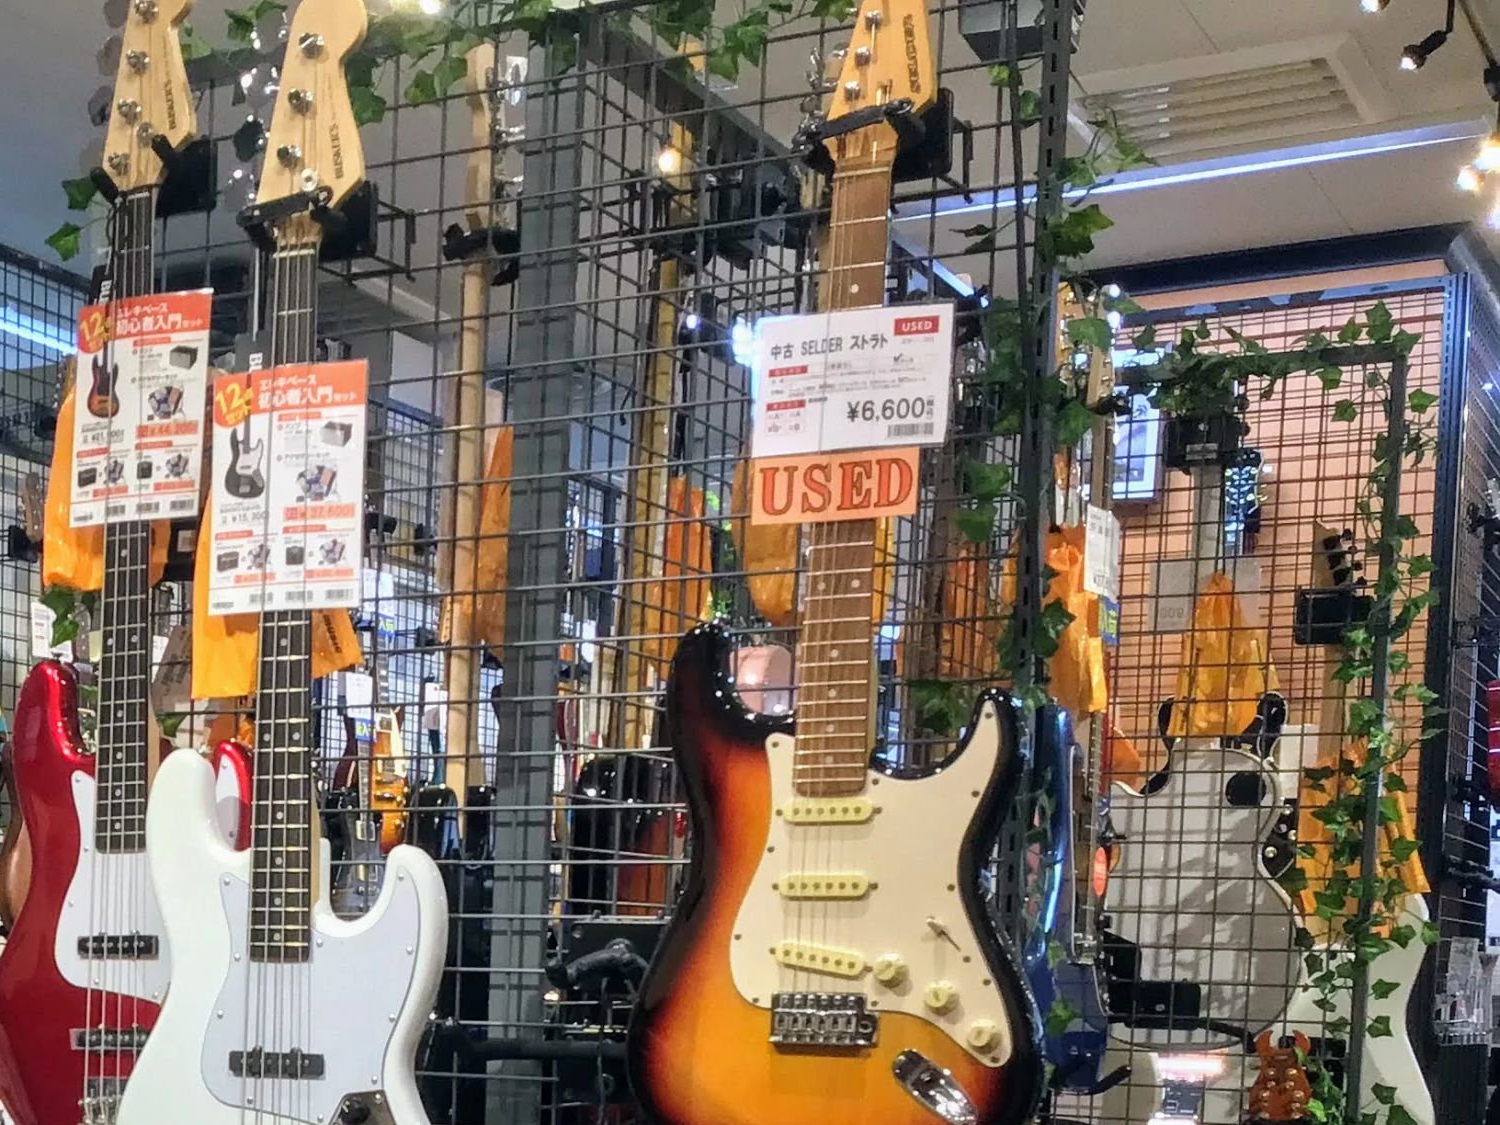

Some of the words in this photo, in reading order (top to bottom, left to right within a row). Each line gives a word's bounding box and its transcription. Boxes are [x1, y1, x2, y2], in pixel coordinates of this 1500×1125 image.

[902, 321, 933, 332] USED
[770, 343, 794, 361] 中古
[801, 336, 843, 356] SELDER
[850, 333, 888, 350] ストラト
[847, 397, 926, 423] ¥6,600
[759, 457, 914, 516] USED
